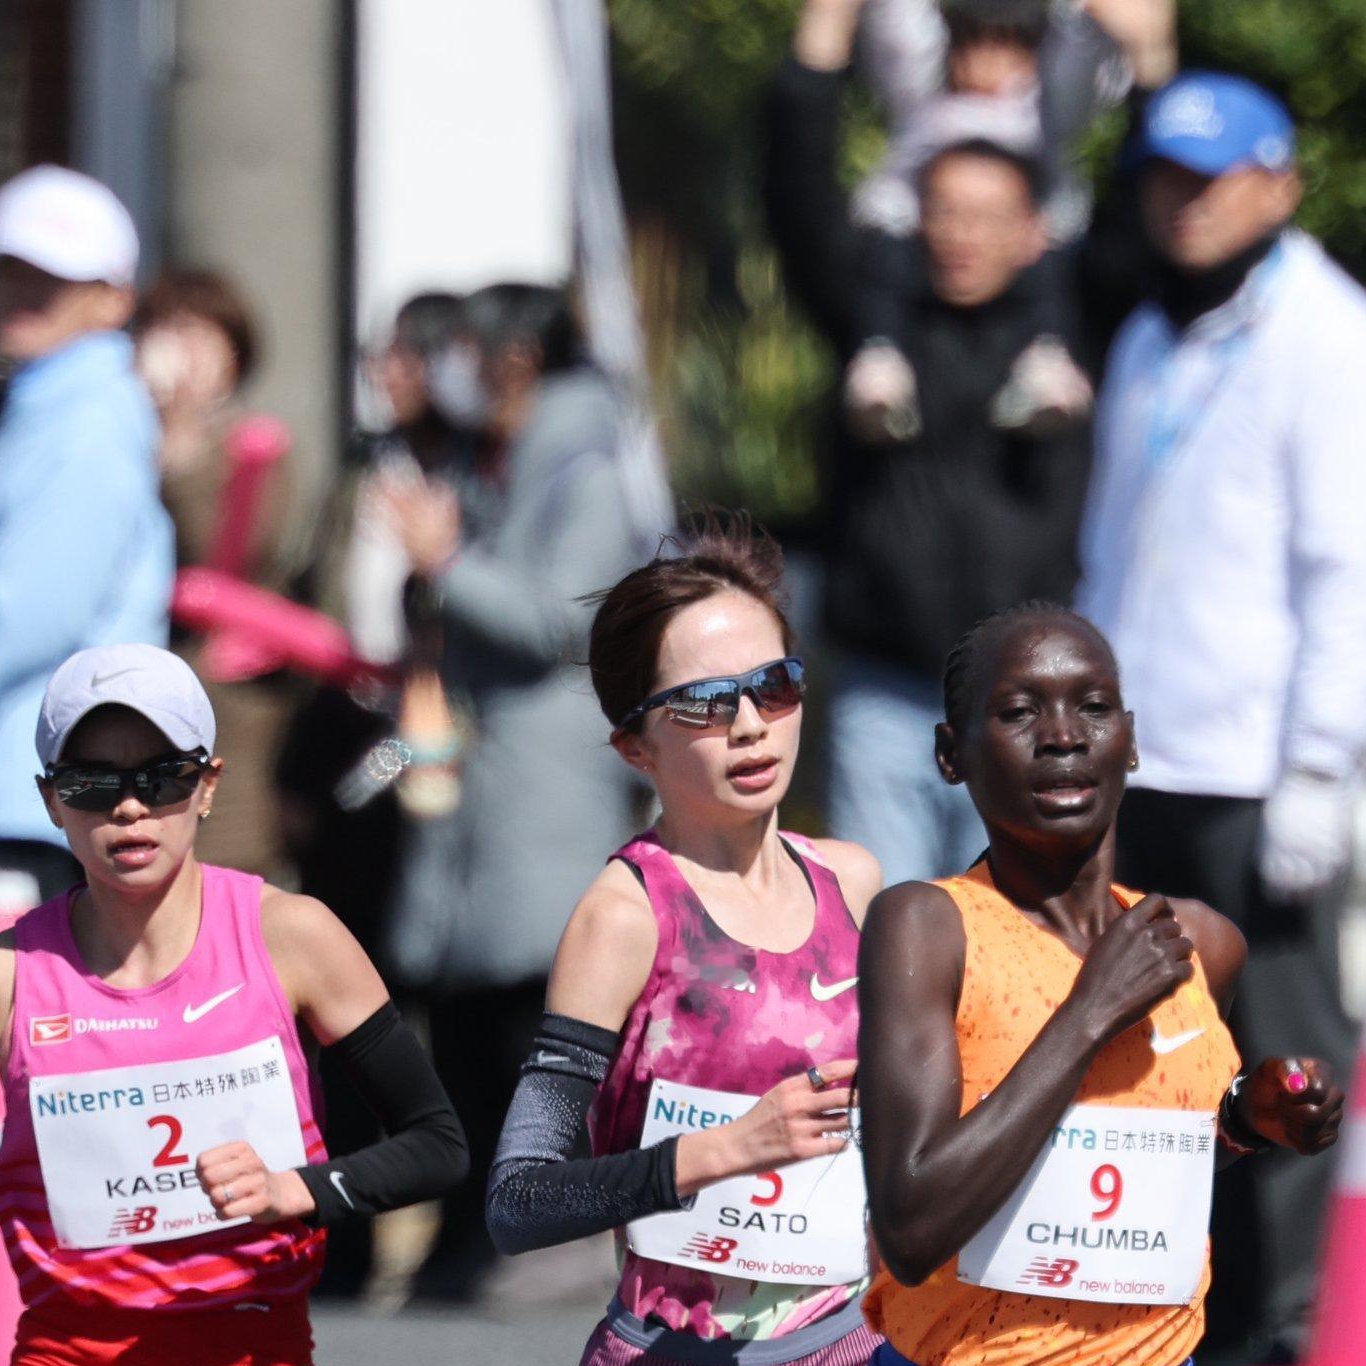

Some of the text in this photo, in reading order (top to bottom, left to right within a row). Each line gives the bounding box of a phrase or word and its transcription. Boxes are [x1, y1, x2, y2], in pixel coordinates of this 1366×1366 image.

[75, 1017, 158, 1035] DAIHATSU
[37, 1060, 281, 1117] Niterra 日本特殊陶業
[653, 1097, 734, 1129] Niter
[147, 1114, 189, 1168] 2
[1105, 1130, 1210, 1155] 日本特殊陶業
[105, 1168, 198, 1199] KASE
[1090, 1163, 1123, 1222] 9
[163, 1218, 194, 1231] new
[718, 1207, 808, 1235] SATO
[1026, 1223, 1168, 1253] CHUMBA
[736, 1257, 767, 1273] new
[771, 1258, 826, 1276] balance
[1079, 1279, 1110, 1292] new
[1114, 1279, 1165, 1295] balance
